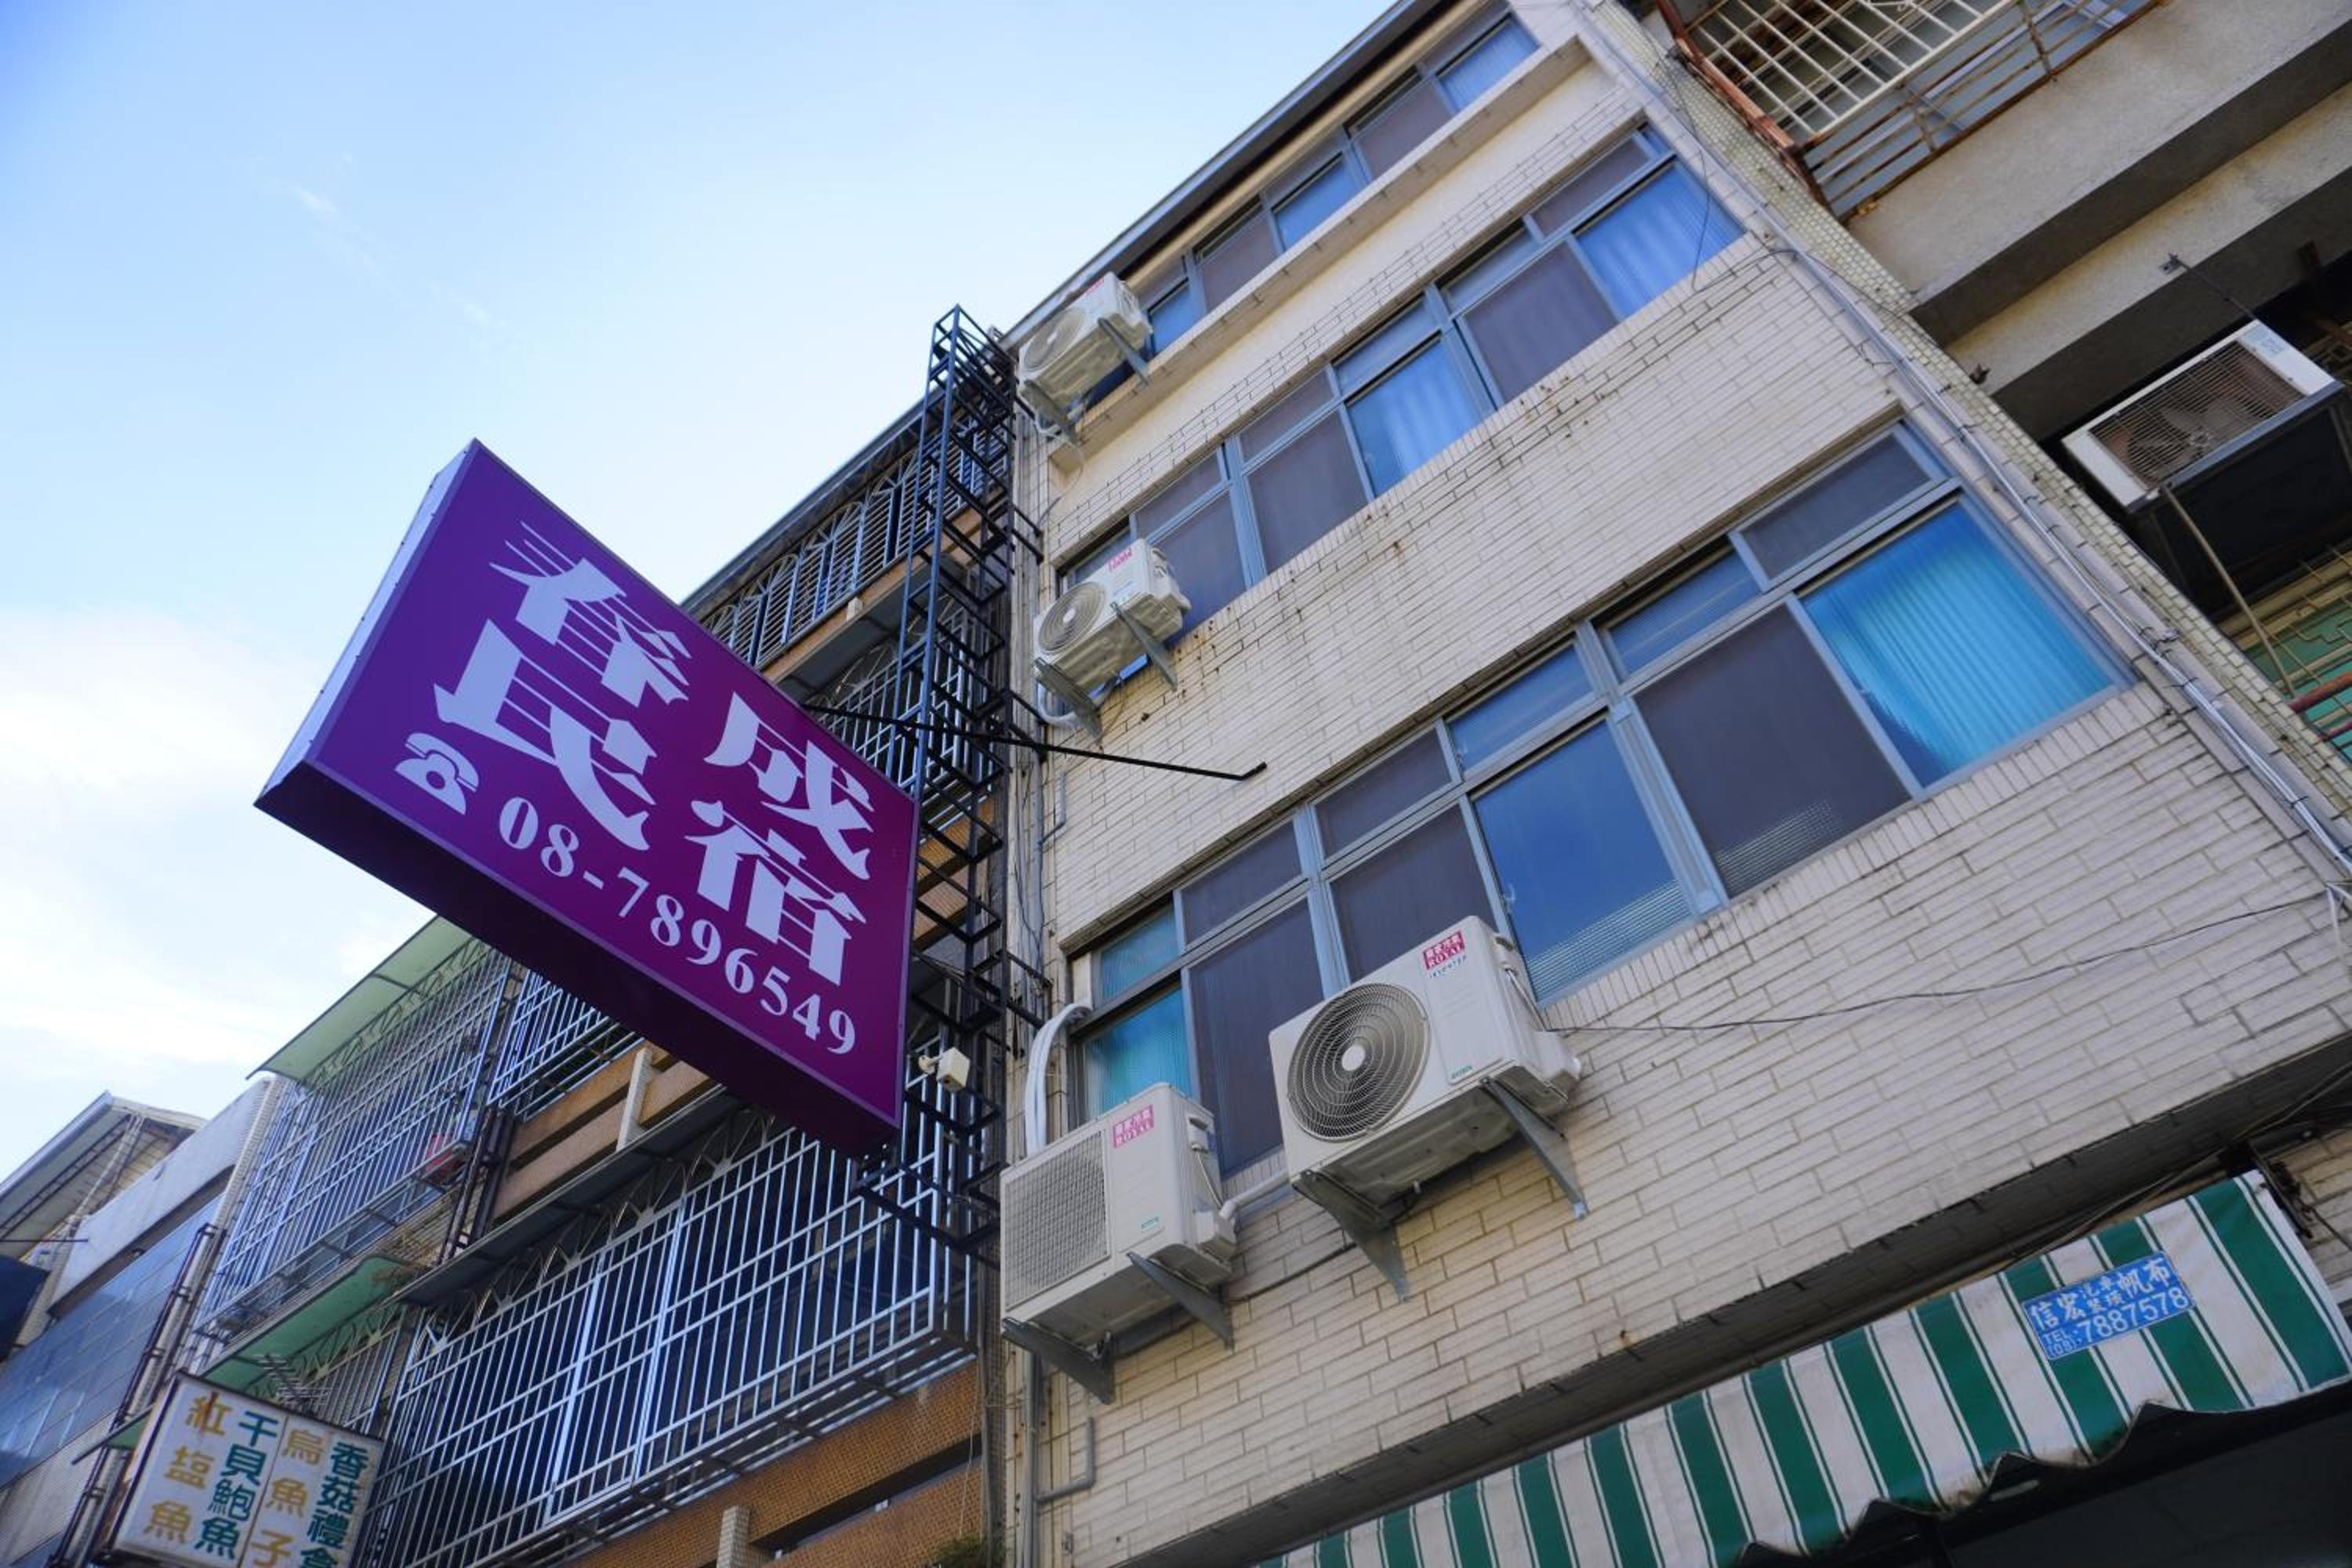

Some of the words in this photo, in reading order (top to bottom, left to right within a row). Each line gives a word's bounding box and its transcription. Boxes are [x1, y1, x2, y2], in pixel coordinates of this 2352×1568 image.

[488, 520, 875, 880] 春成
[434, 618, 866, 987] 民宿
[499, 796, 855, 1054] 08-7896549
[1428, 943, 1463, 968] ROYAL
[2029, 1292, 2087, 1331] 信宏
[2117, 1257, 2171, 1300] 帆布
[2076, 1287, 2189, 1343] 7887578
[193, 1410, 279, 1560] 干貝鮑魚
